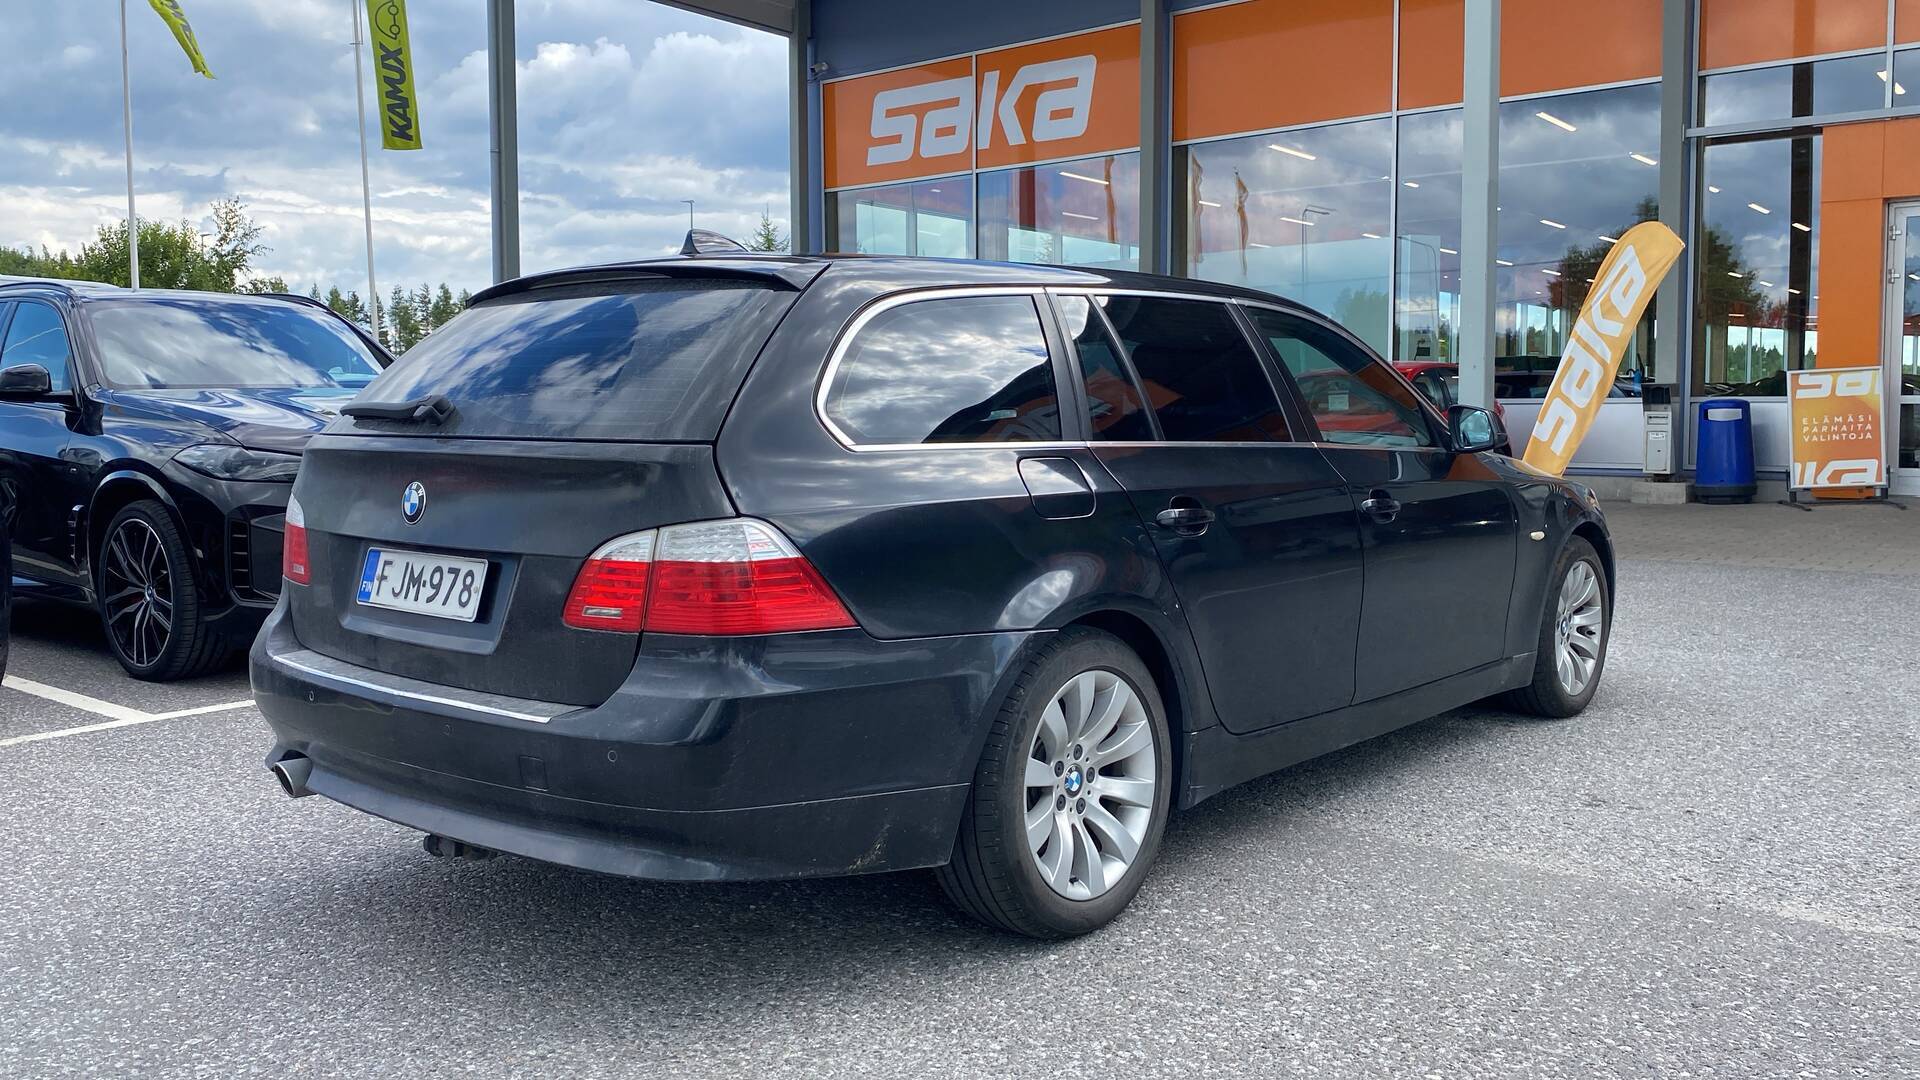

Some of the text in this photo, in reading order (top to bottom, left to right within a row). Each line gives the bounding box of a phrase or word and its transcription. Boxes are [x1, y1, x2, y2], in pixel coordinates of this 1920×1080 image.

[379, 41, 414, 141] KAMUX
[1802, 414, 1872, 425] ELÄMÄSI
[1802, 422, 1872, 434] PARHAITA
[1803, 432, 1872, 442] VALINTOJA
[361, 580, 373, 593] FIN
[376, 560, 475, 608] FJM-978
